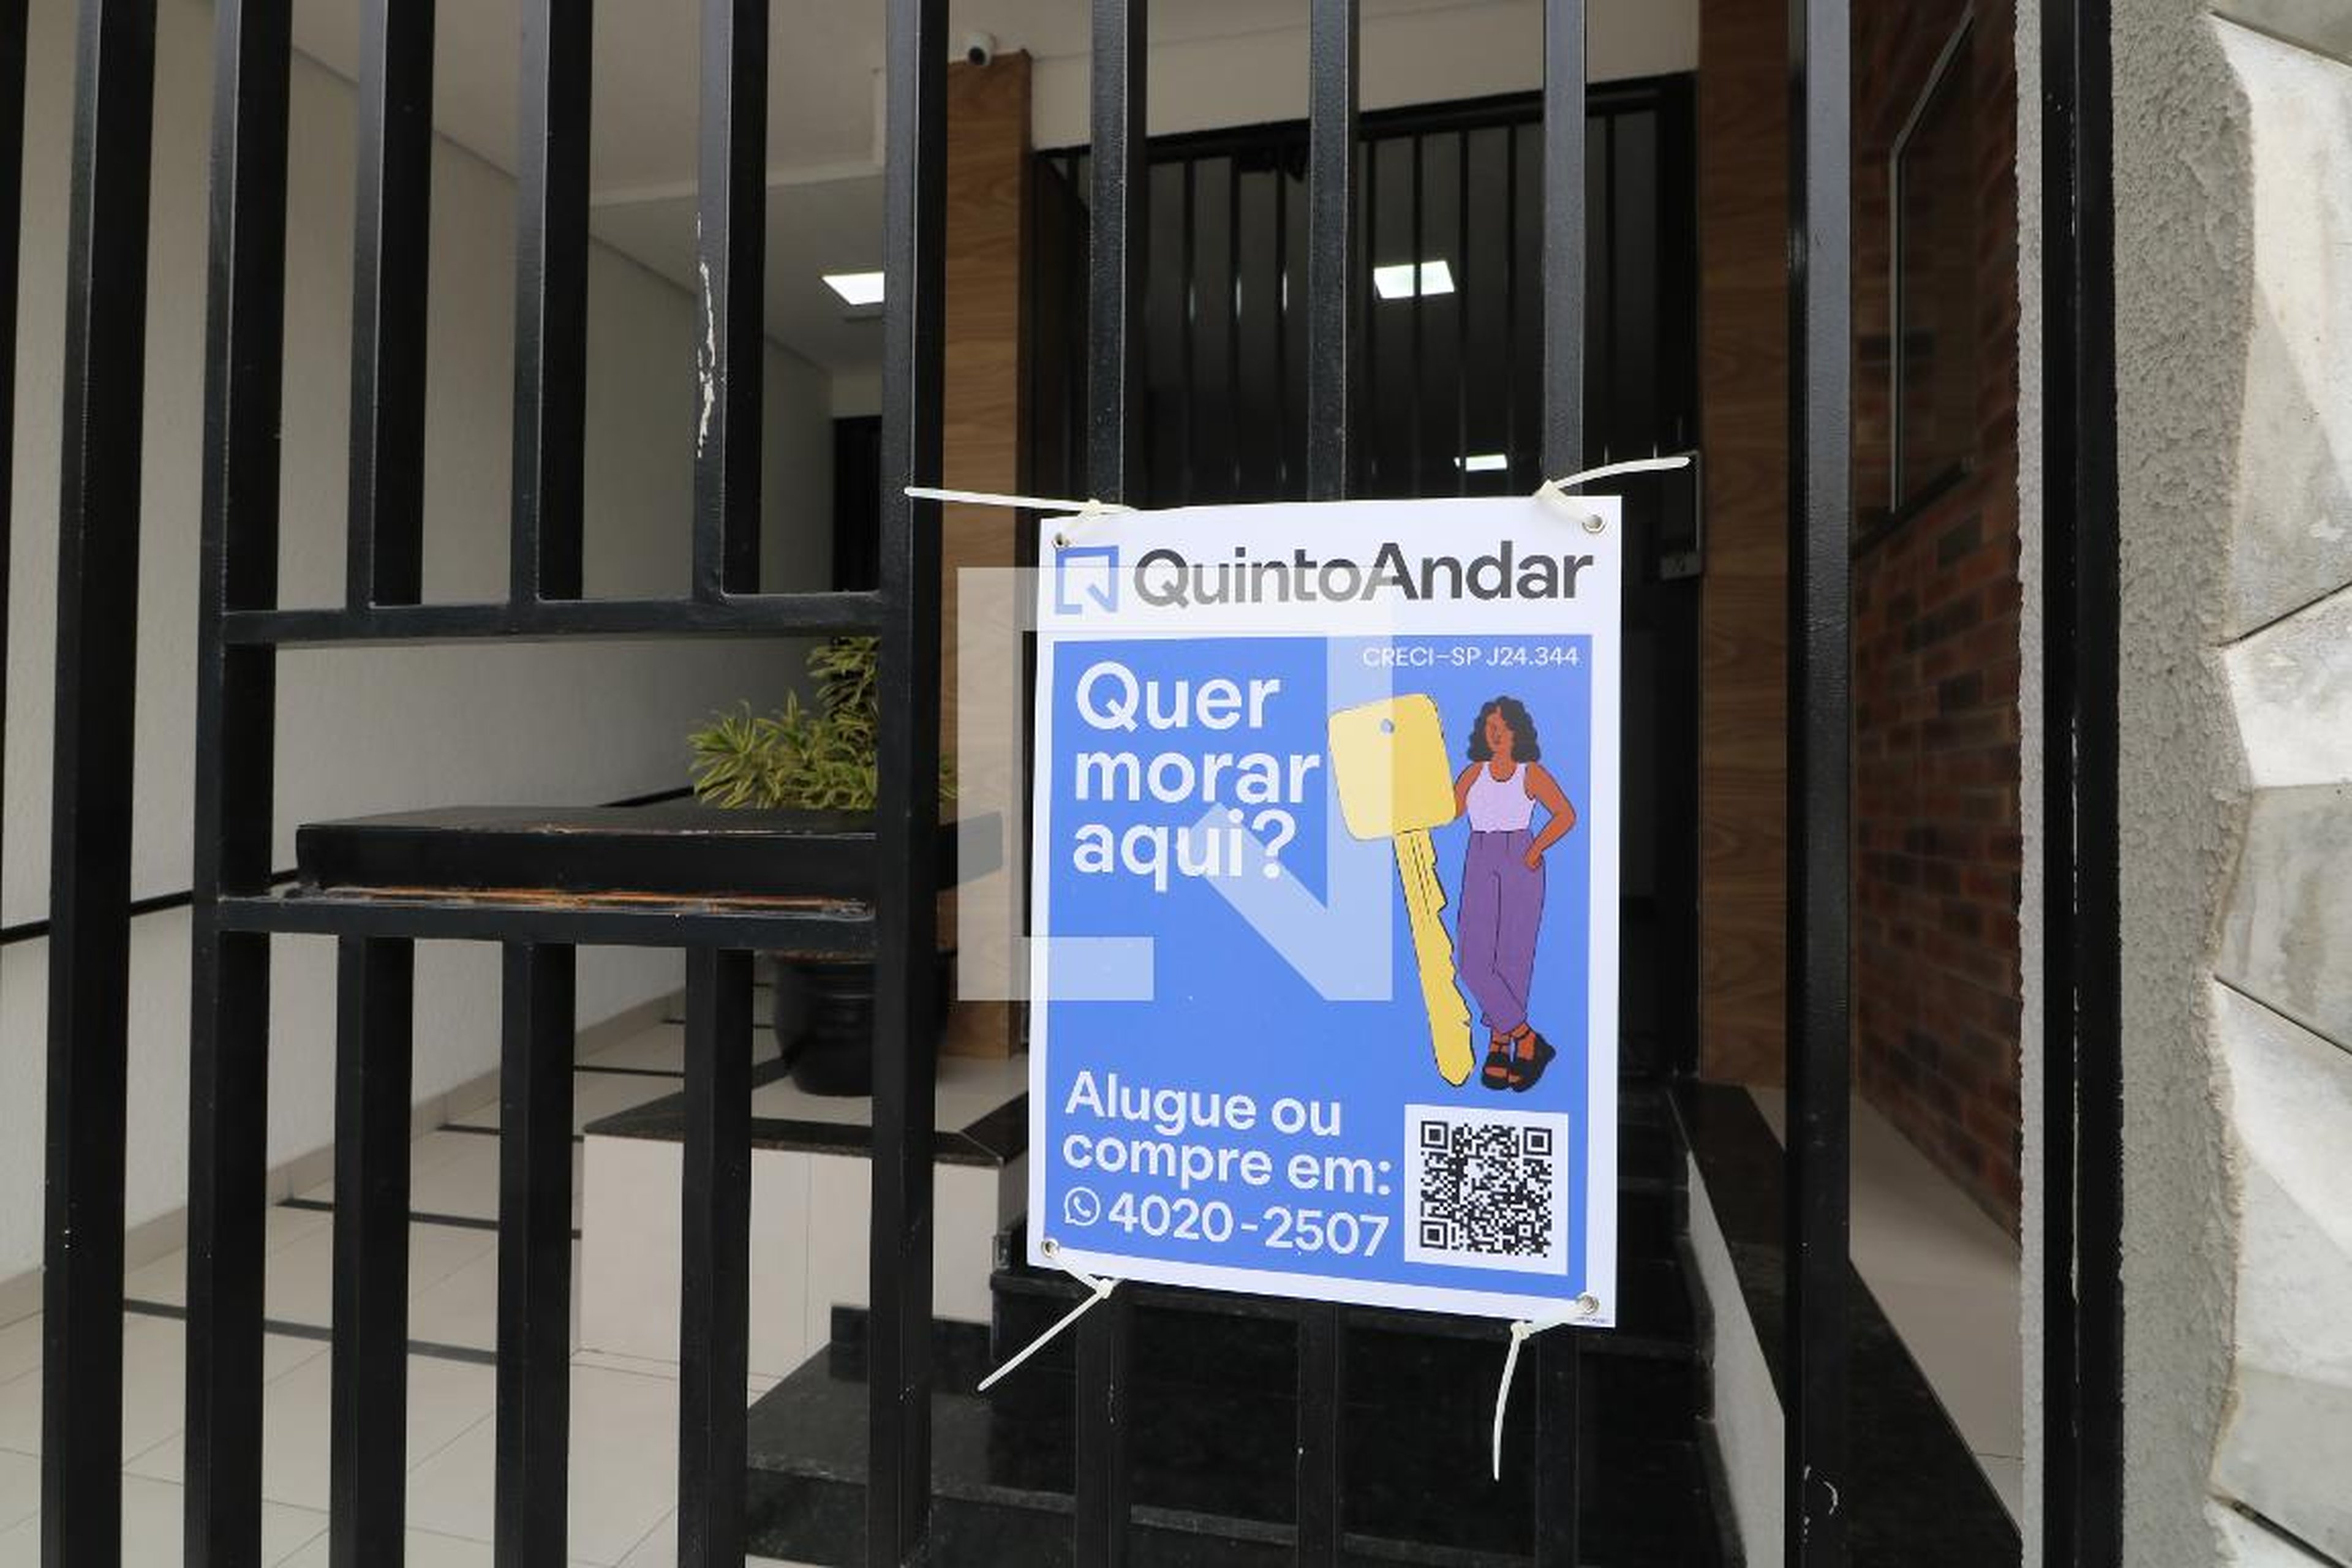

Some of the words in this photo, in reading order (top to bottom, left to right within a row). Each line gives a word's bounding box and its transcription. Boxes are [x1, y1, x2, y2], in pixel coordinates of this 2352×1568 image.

[1134, 540, 1594, 609] QuintoAndar
[1485, 646, 1580, 668] J24.344
[1076, 661, 1281, 733] Quer
[1075, 750, 1321, 804] morar
[1072, 808, 1296, 892] aqui?
[1064, 1070, 1257, 1137] Alugue
[1271, 1095, 1341, 1137] ou
[1063, 1133, 1273, 1191] compre
[1287, 1152, 1392, 1196] em:
